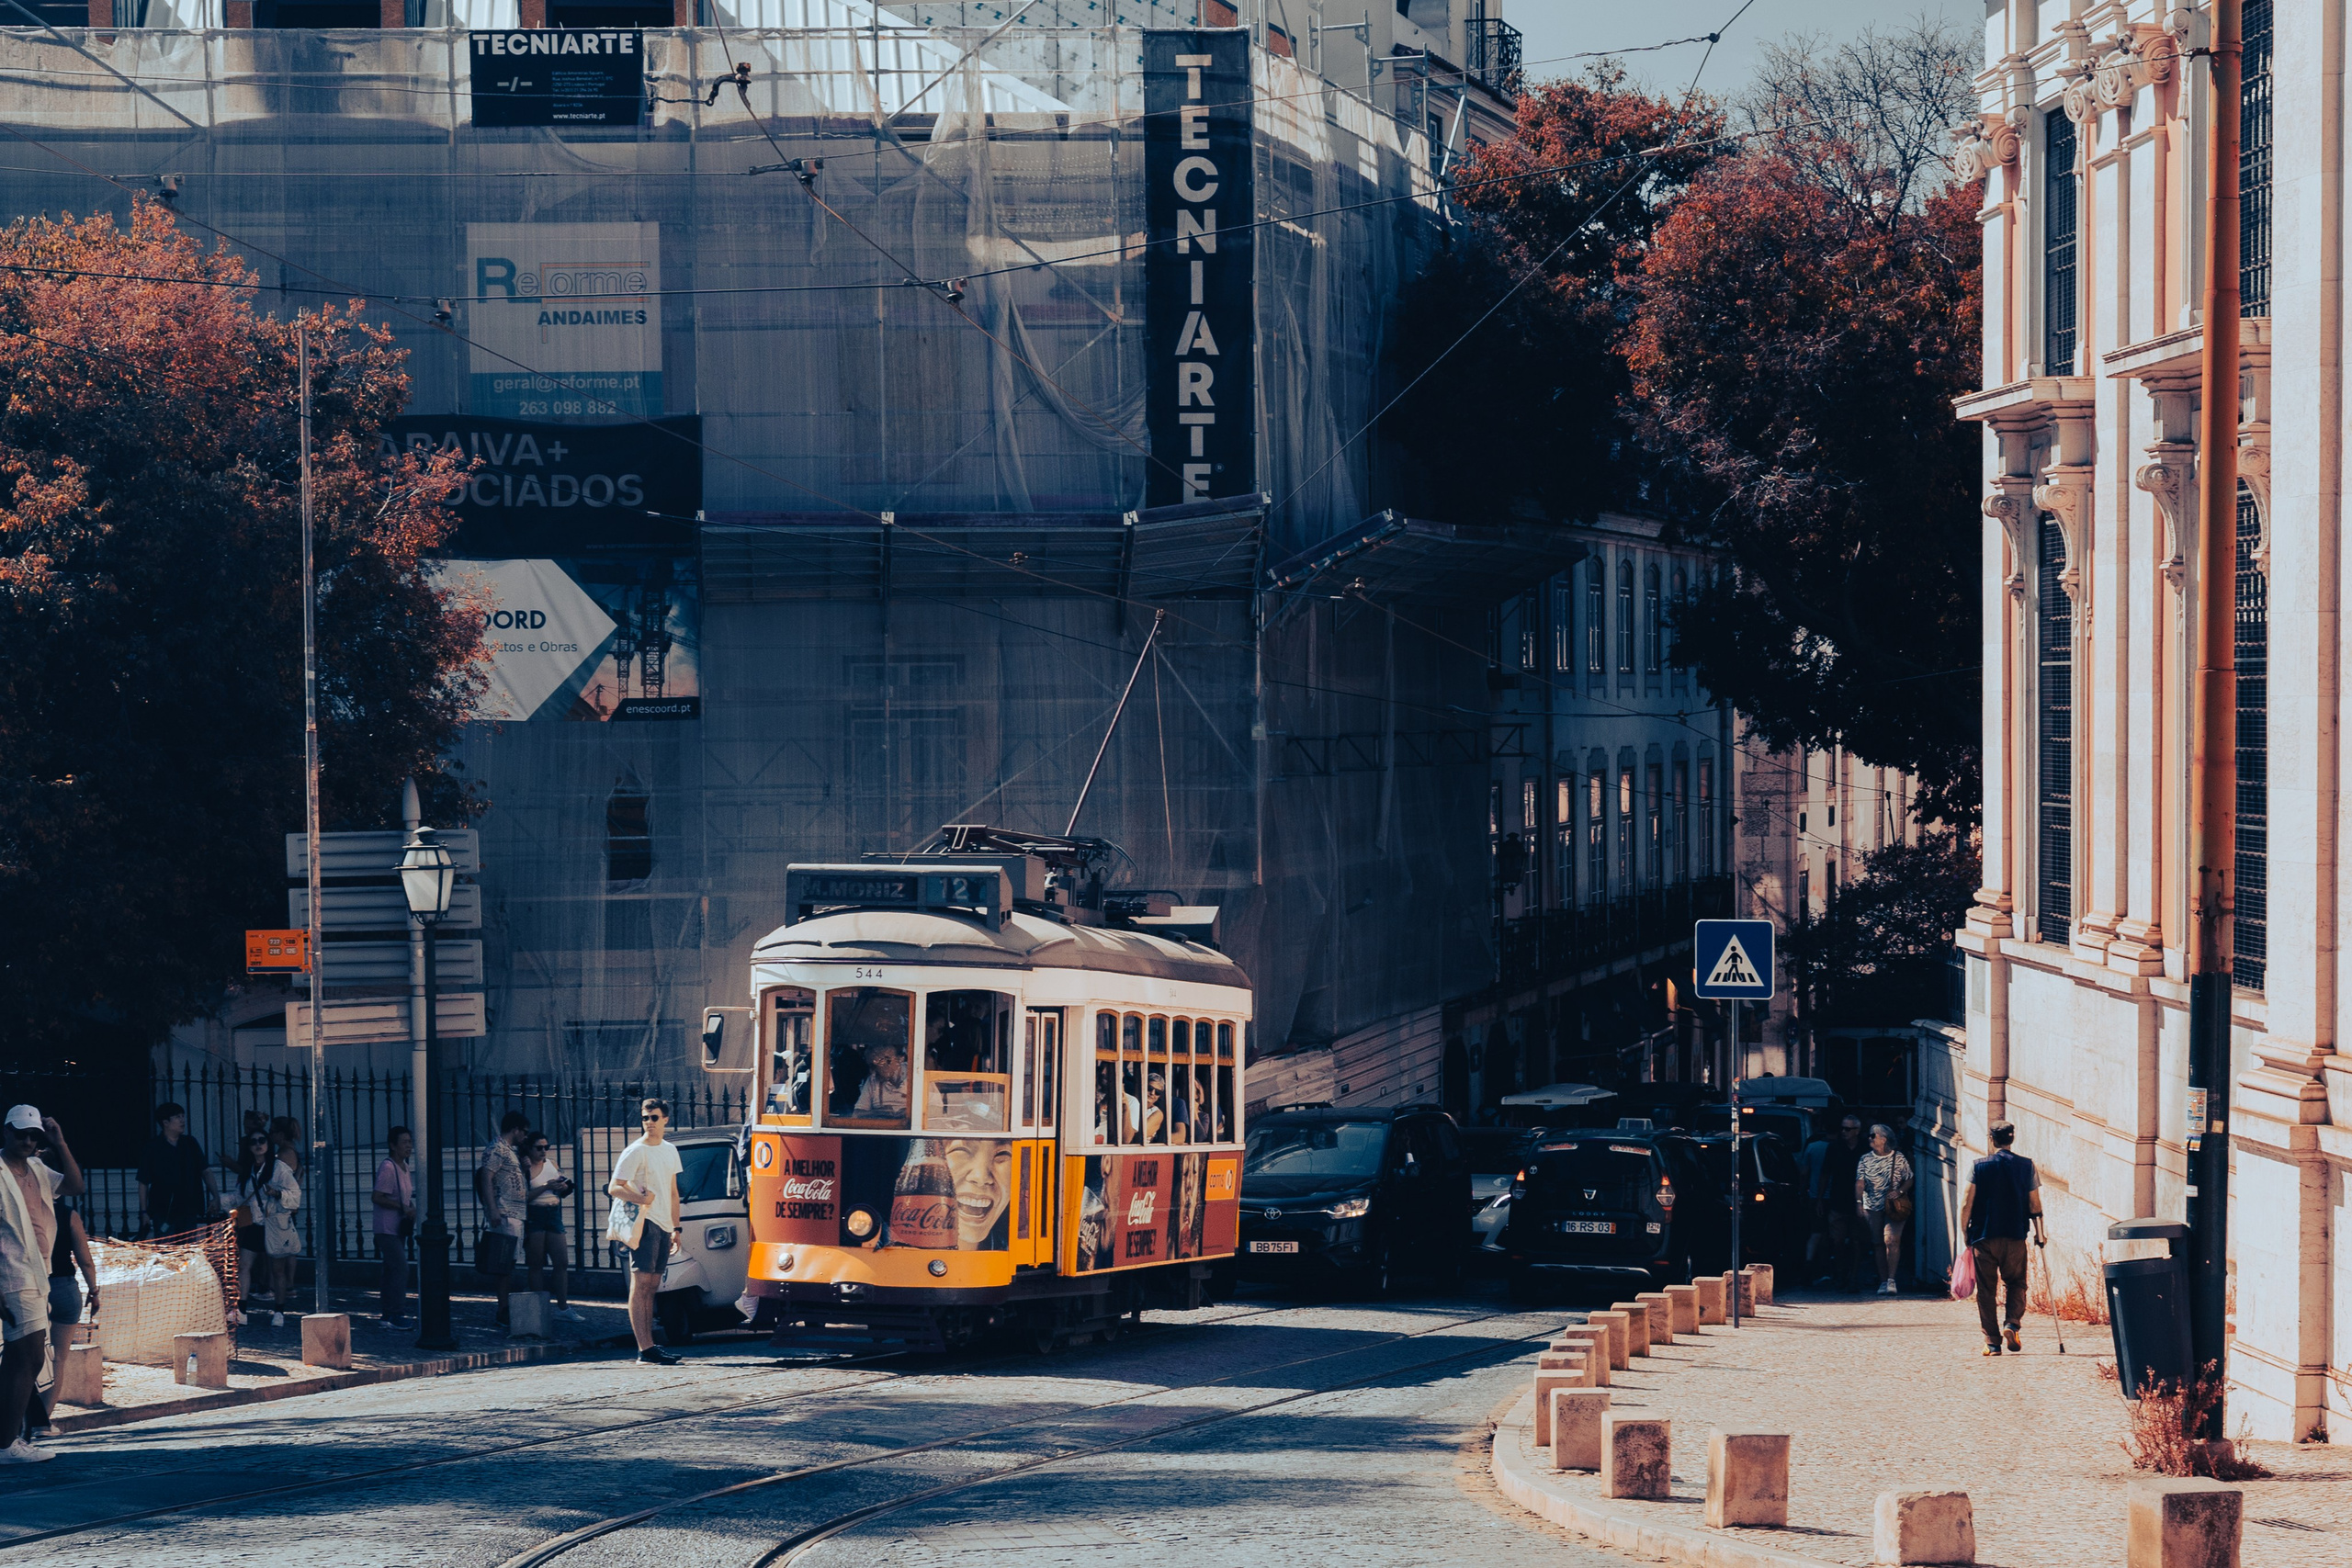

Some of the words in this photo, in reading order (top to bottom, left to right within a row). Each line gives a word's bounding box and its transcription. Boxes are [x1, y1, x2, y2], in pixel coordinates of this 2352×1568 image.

[472, 33, 634, 55] TECNIARTE
[552, 112, 606, 120] www.tecniarte.pt
[1172, 53, 1220, 503] TECNIARTE
[537, 310, 648, 326] ANDAIMES
[493, 375, 640, 393] geral@reforme.pt
[519, 400, 548, 415] 263
[553, 400, 582, 415] 098
[587, 400, 617, 415] 882
[527, 643, 536, 653] e
[539, 640, 578, 653] Obras
[625, 705, 692, 717] enescoord.pt
[939, 876, 969, 900] 12
[855, 967, 883, 979] 544
[784, 1159, 790, 1176] A
[792, 1158, 836, 1178] MELHOR
[783, 1178, 835, 1201] Coca-Cola
[775, 1201, 786, 1219] DE
[787, 1201, 835, 1221] SEMPRE?
[891, 1201, 956, 1230] Coca-Cola
[1127, 1190, 1156, 1226] Coca-Cola
